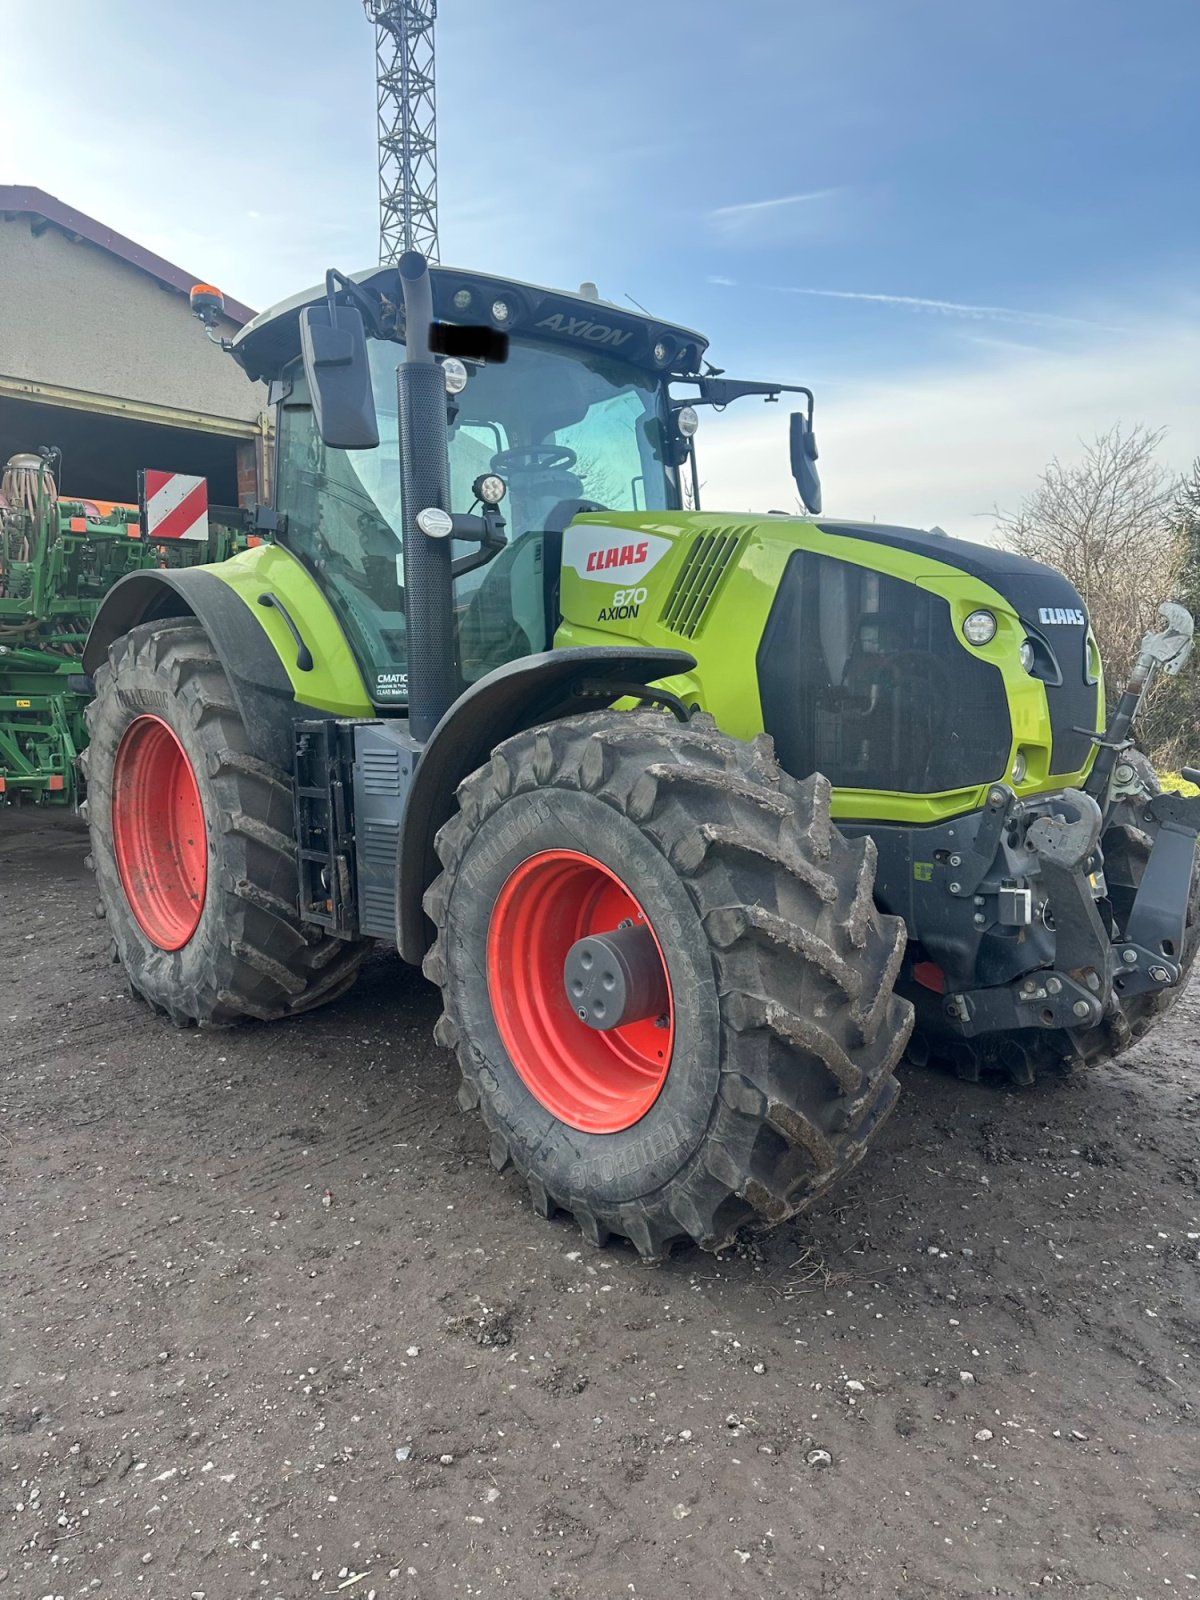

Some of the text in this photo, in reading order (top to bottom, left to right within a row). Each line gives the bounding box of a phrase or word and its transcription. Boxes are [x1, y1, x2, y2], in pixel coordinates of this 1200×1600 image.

[534, 313, 633, 346] AXION
[586, 542, 648, 572] CLAAS
[613, 587, 648, 607] 870
[597, 604, 640, 622] AXION
[1038, 607, 1085, 625] CLAAS
[377, 674, 408, 683] CMATIC
